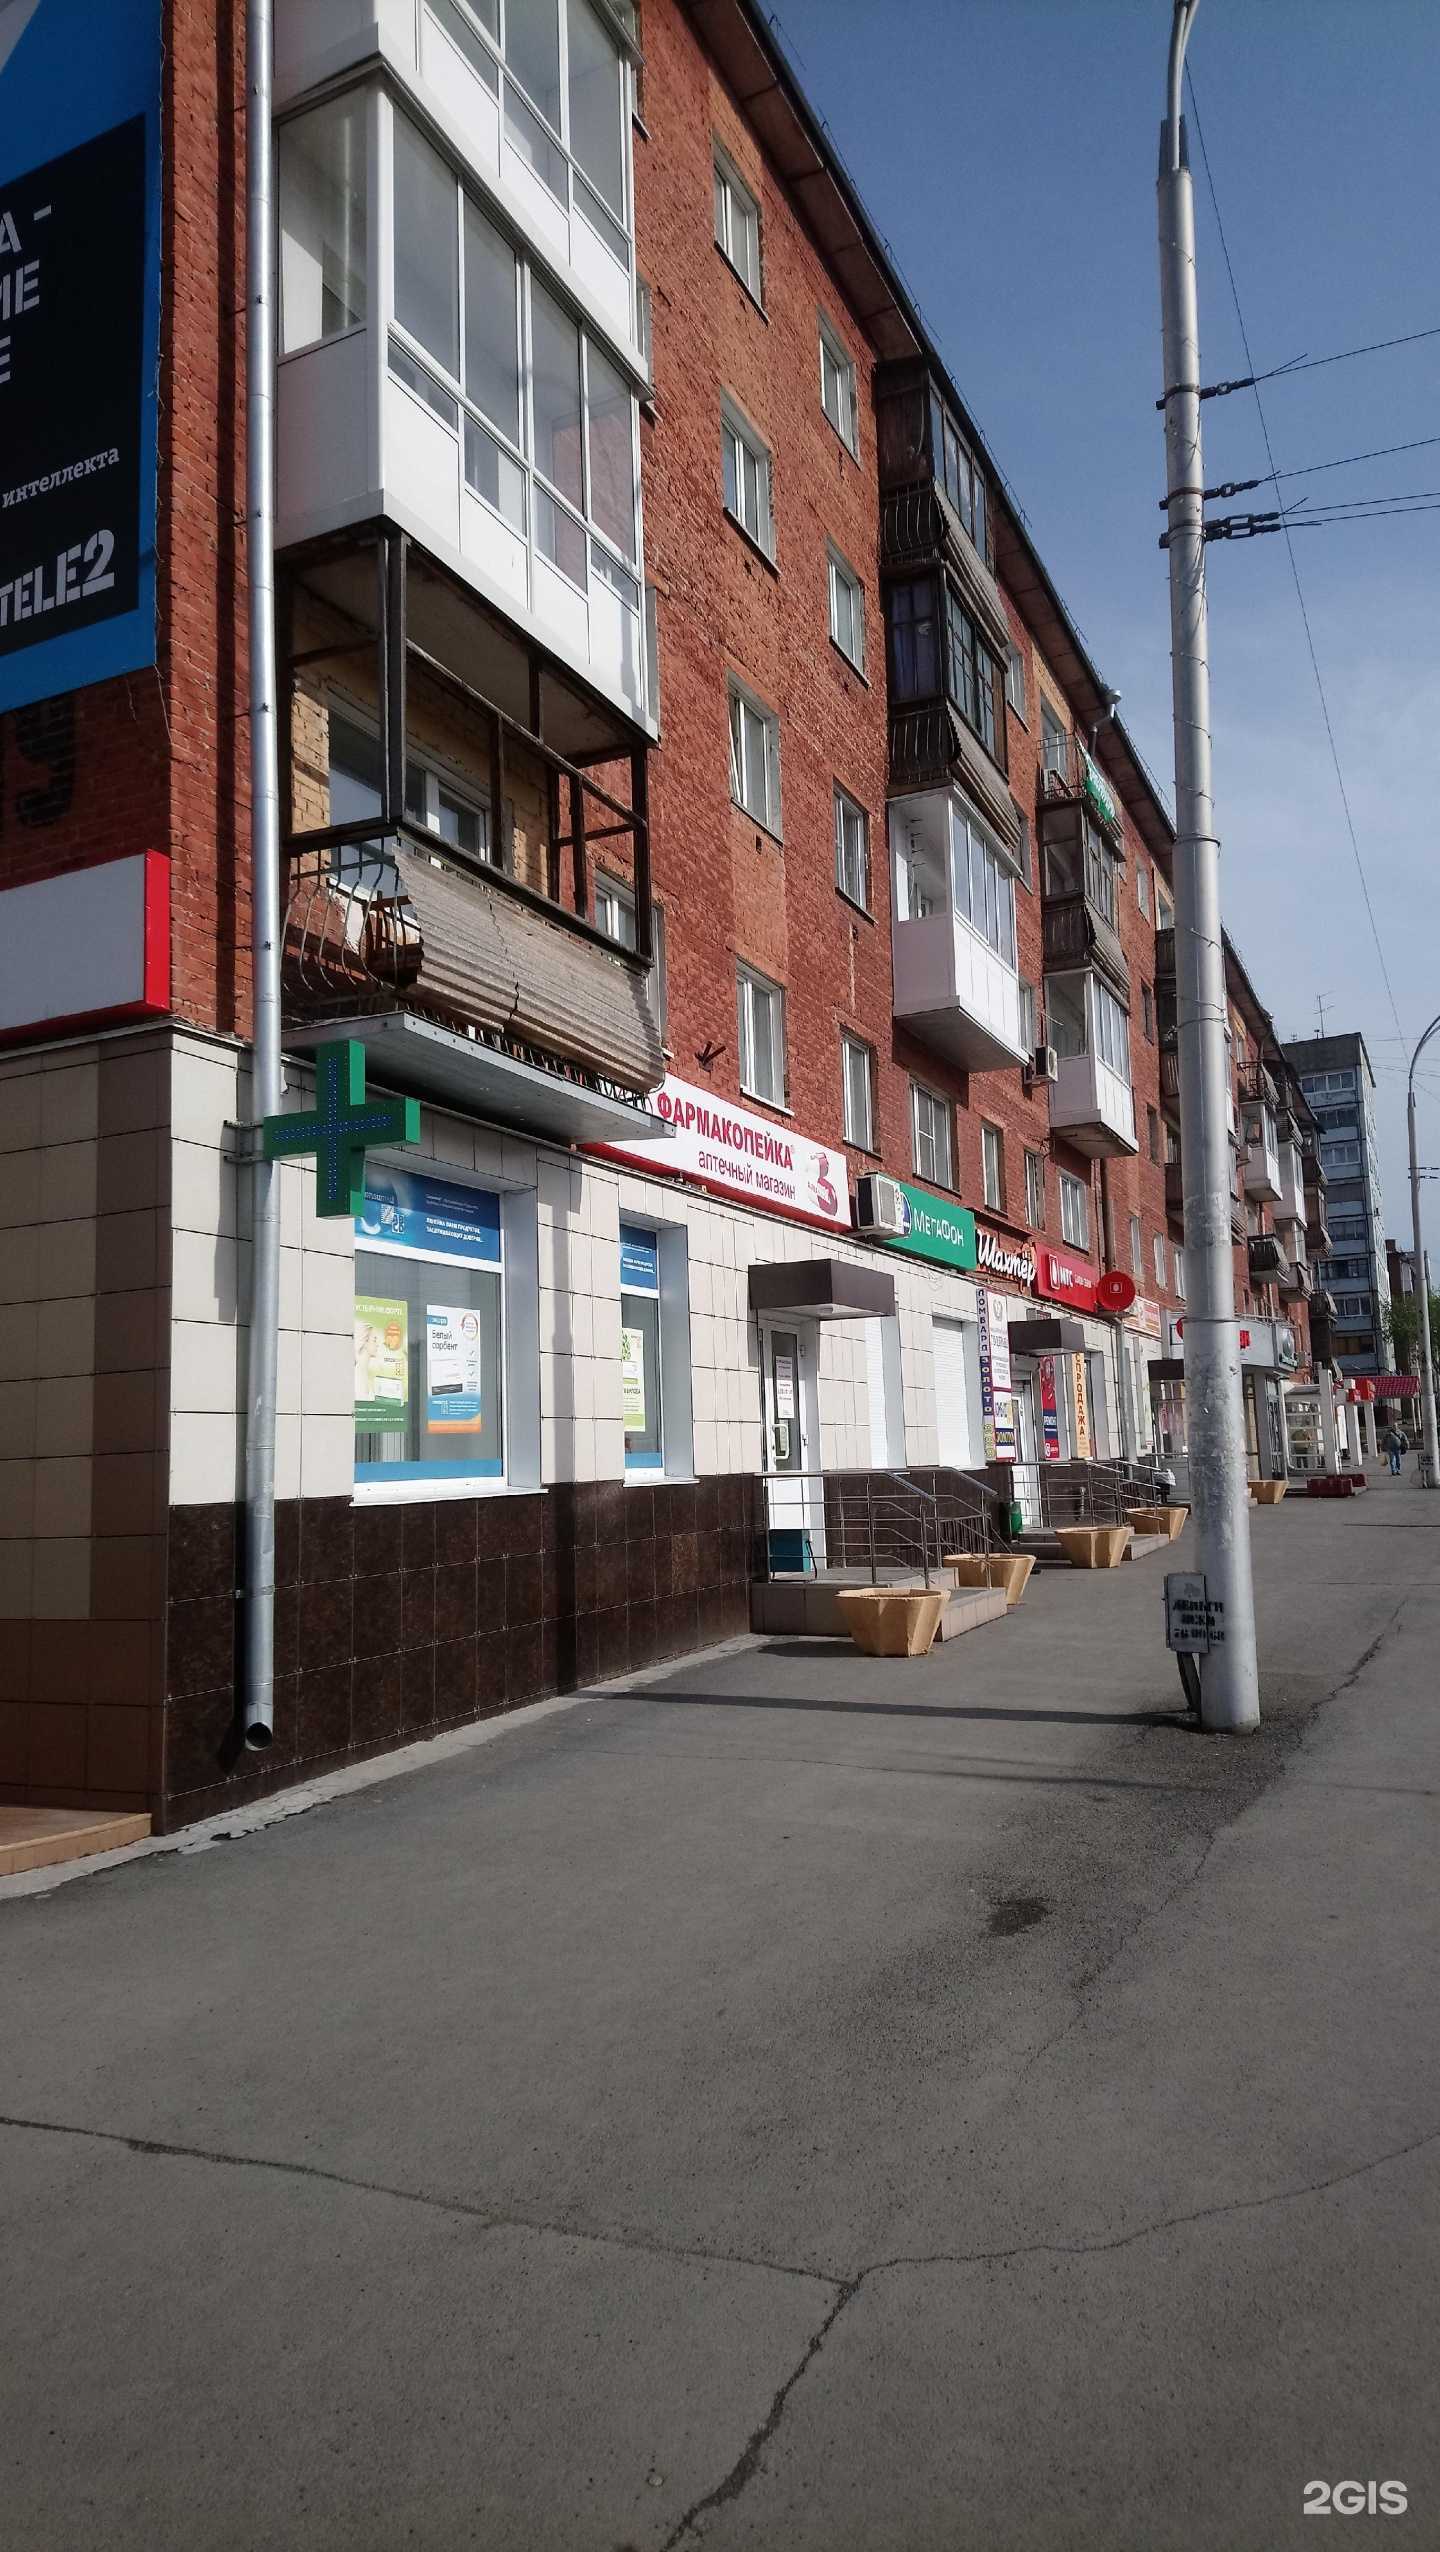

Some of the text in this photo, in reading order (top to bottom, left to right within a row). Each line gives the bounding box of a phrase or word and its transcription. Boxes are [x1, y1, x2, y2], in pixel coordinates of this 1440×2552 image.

[2, 448, 119, 508] интеллекта
[0, 529, 115, 627] TELE2
[657, 1092, 793, 1171] ФАРМАКОПЕЙКА
[699, 1150, 753, 1184] аптечный
[756, 1173, 796, 1200] магазин
[976, 1229, 1037, 1288] Шахтёр
[432, 1329, 453, 1340] Белый
[977, 1289, 989, 1352] ЛОМБАРД
[980, 1356, 993, 1413] ЗОЛОТО
